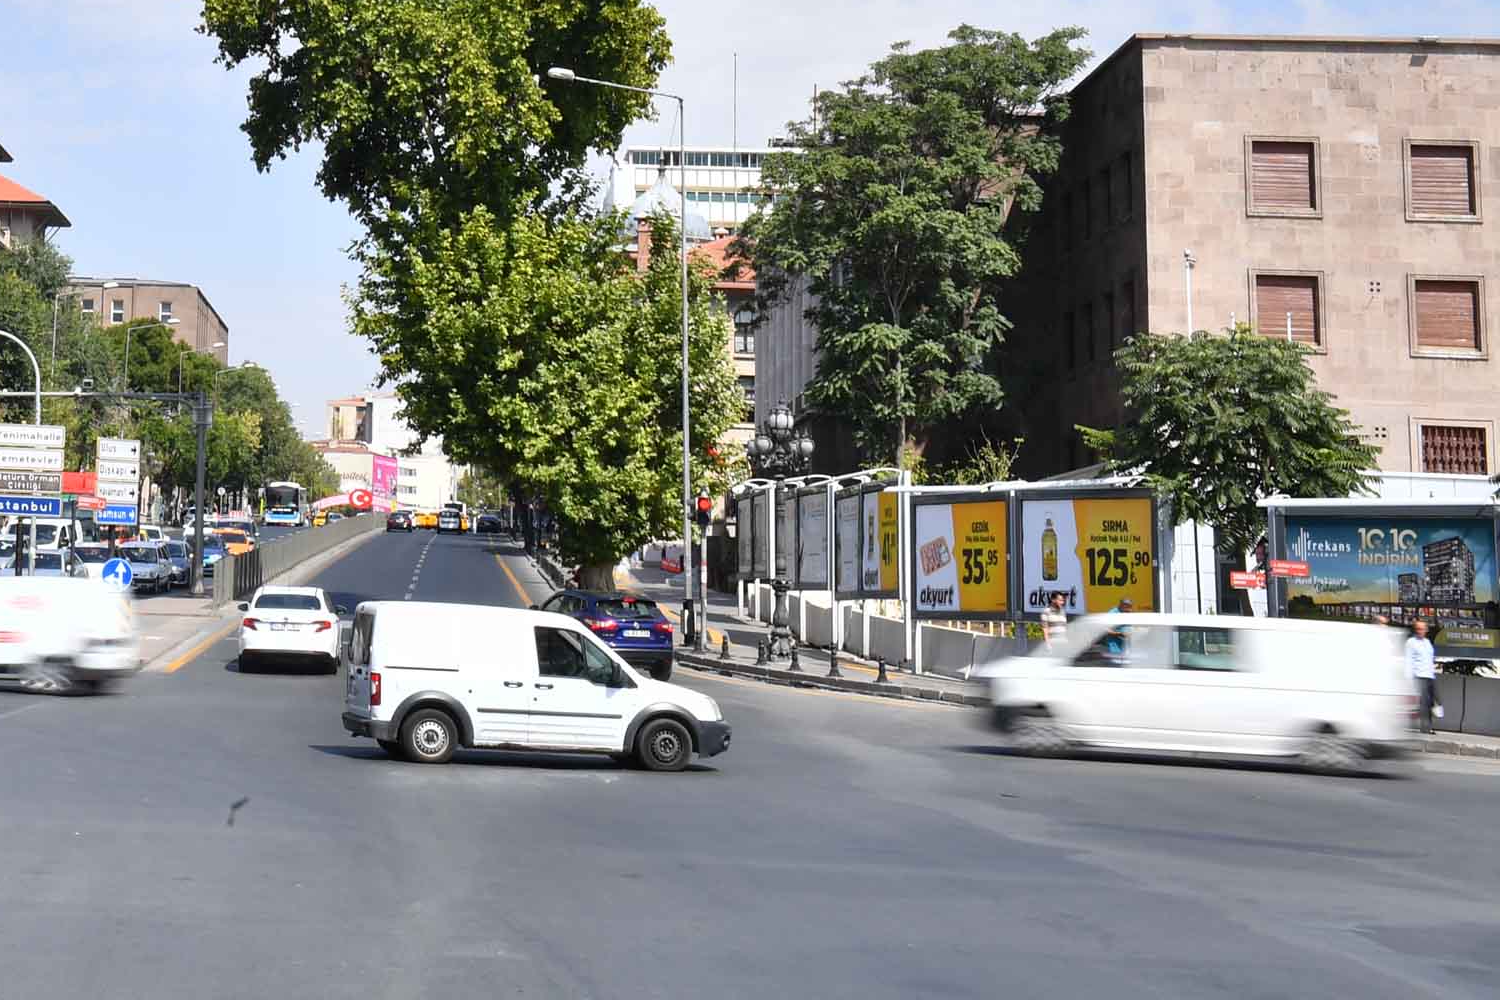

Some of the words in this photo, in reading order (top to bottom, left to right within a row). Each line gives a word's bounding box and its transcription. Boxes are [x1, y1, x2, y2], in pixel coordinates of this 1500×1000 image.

[1102, 520, 1128, 533] SIRMA
[1307, 538, 1351, 553] frekans
[1086, 548, 1128, 586] 125
[920, 587, 953, 606] akyurt
[1029, 584, 1077, 609] akyt
